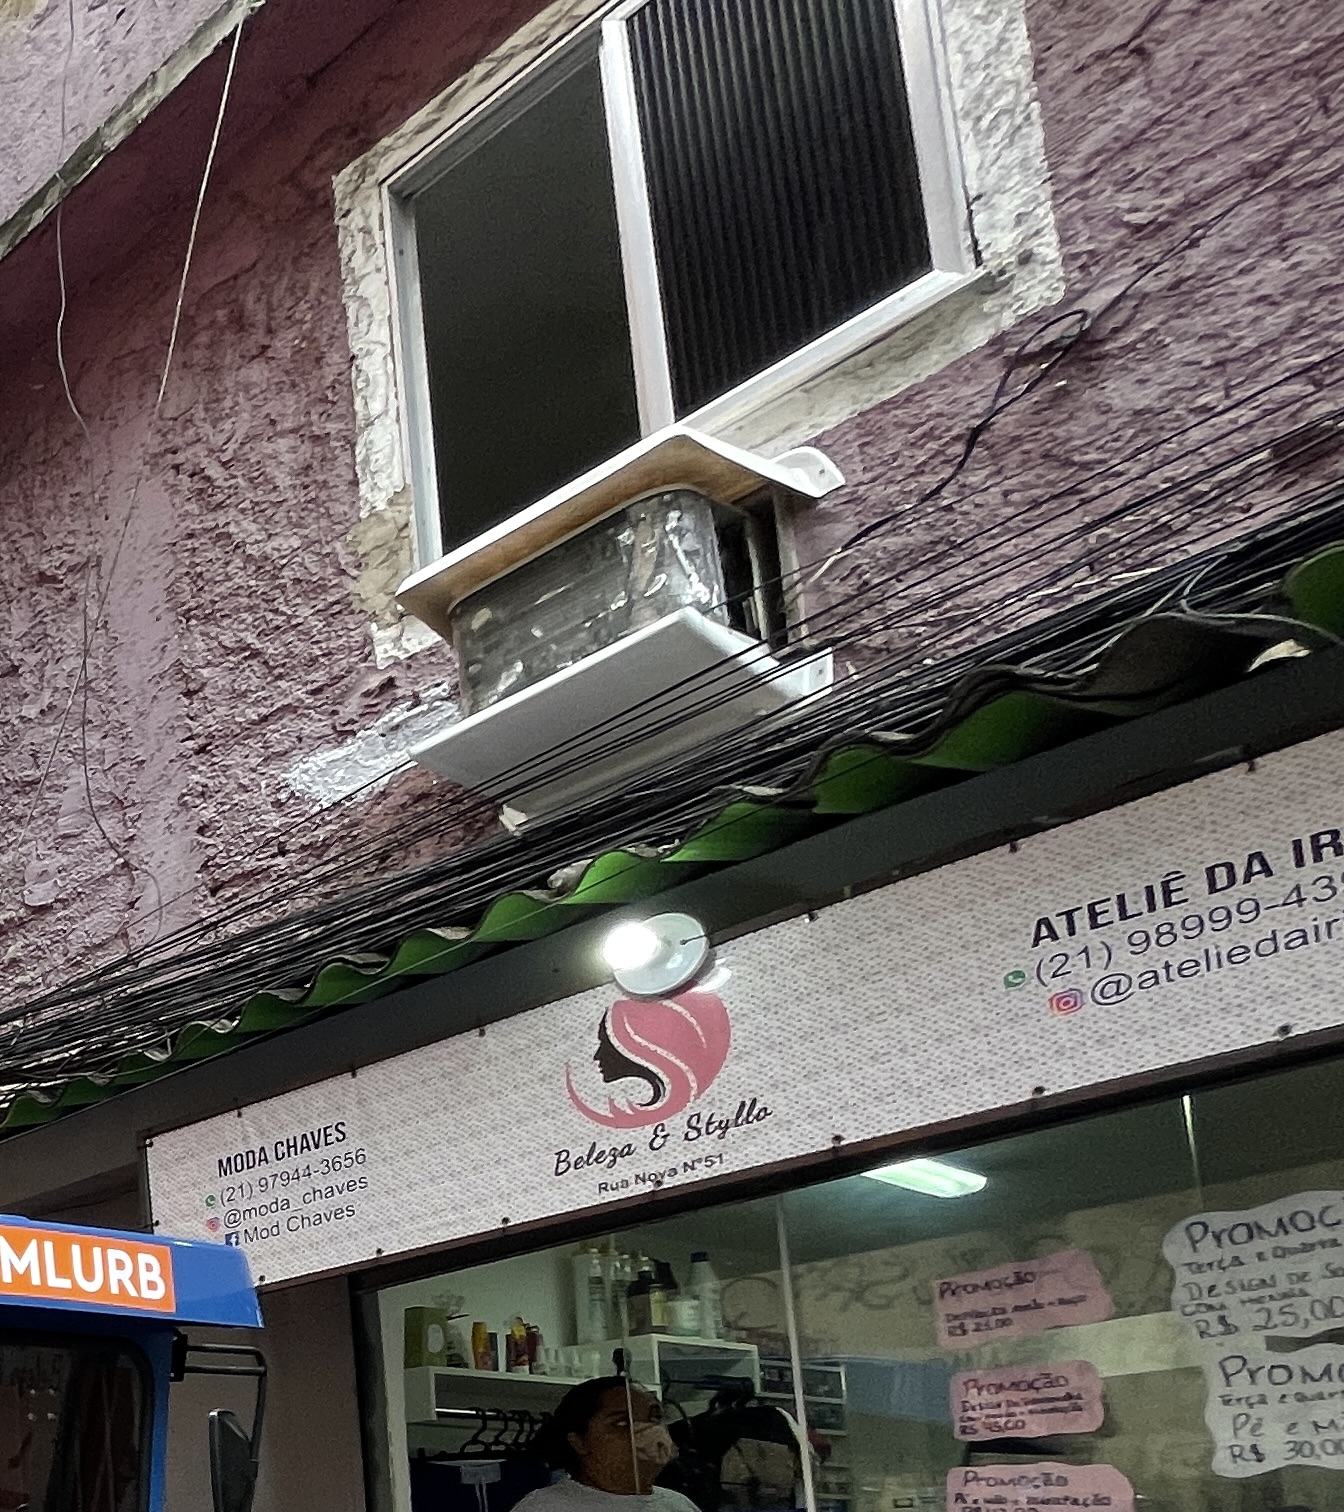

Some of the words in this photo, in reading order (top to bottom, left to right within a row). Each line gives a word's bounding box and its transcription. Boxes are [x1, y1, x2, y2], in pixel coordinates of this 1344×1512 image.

[1205, 851, 1274, 895] DA
[1036, 940, 1112, 987] (21)
[1126, 873, 1344, 955] 98999-43
[1090, 912, 1344, 1007] @ateliedair
[218, 1146, 269, 1178] MODA
[274, 1122, 347, 1161] CHAVES
[554, 1141, 636, 1176] Beleza
[649, 1123, 670, 1150] &
[221, 1181, 253, 1207] (21)
[258, 1148, 367, 1193] 97944-3656
[223, 1176, 369, 1228] @moda_chaves
[598, 1179, 629, 1194] Rua
[634, 1166, 678, 1184] Nova
[244, 1221, 280, 1244] Mod
[286, 1204, 356, 1232] Chaves
